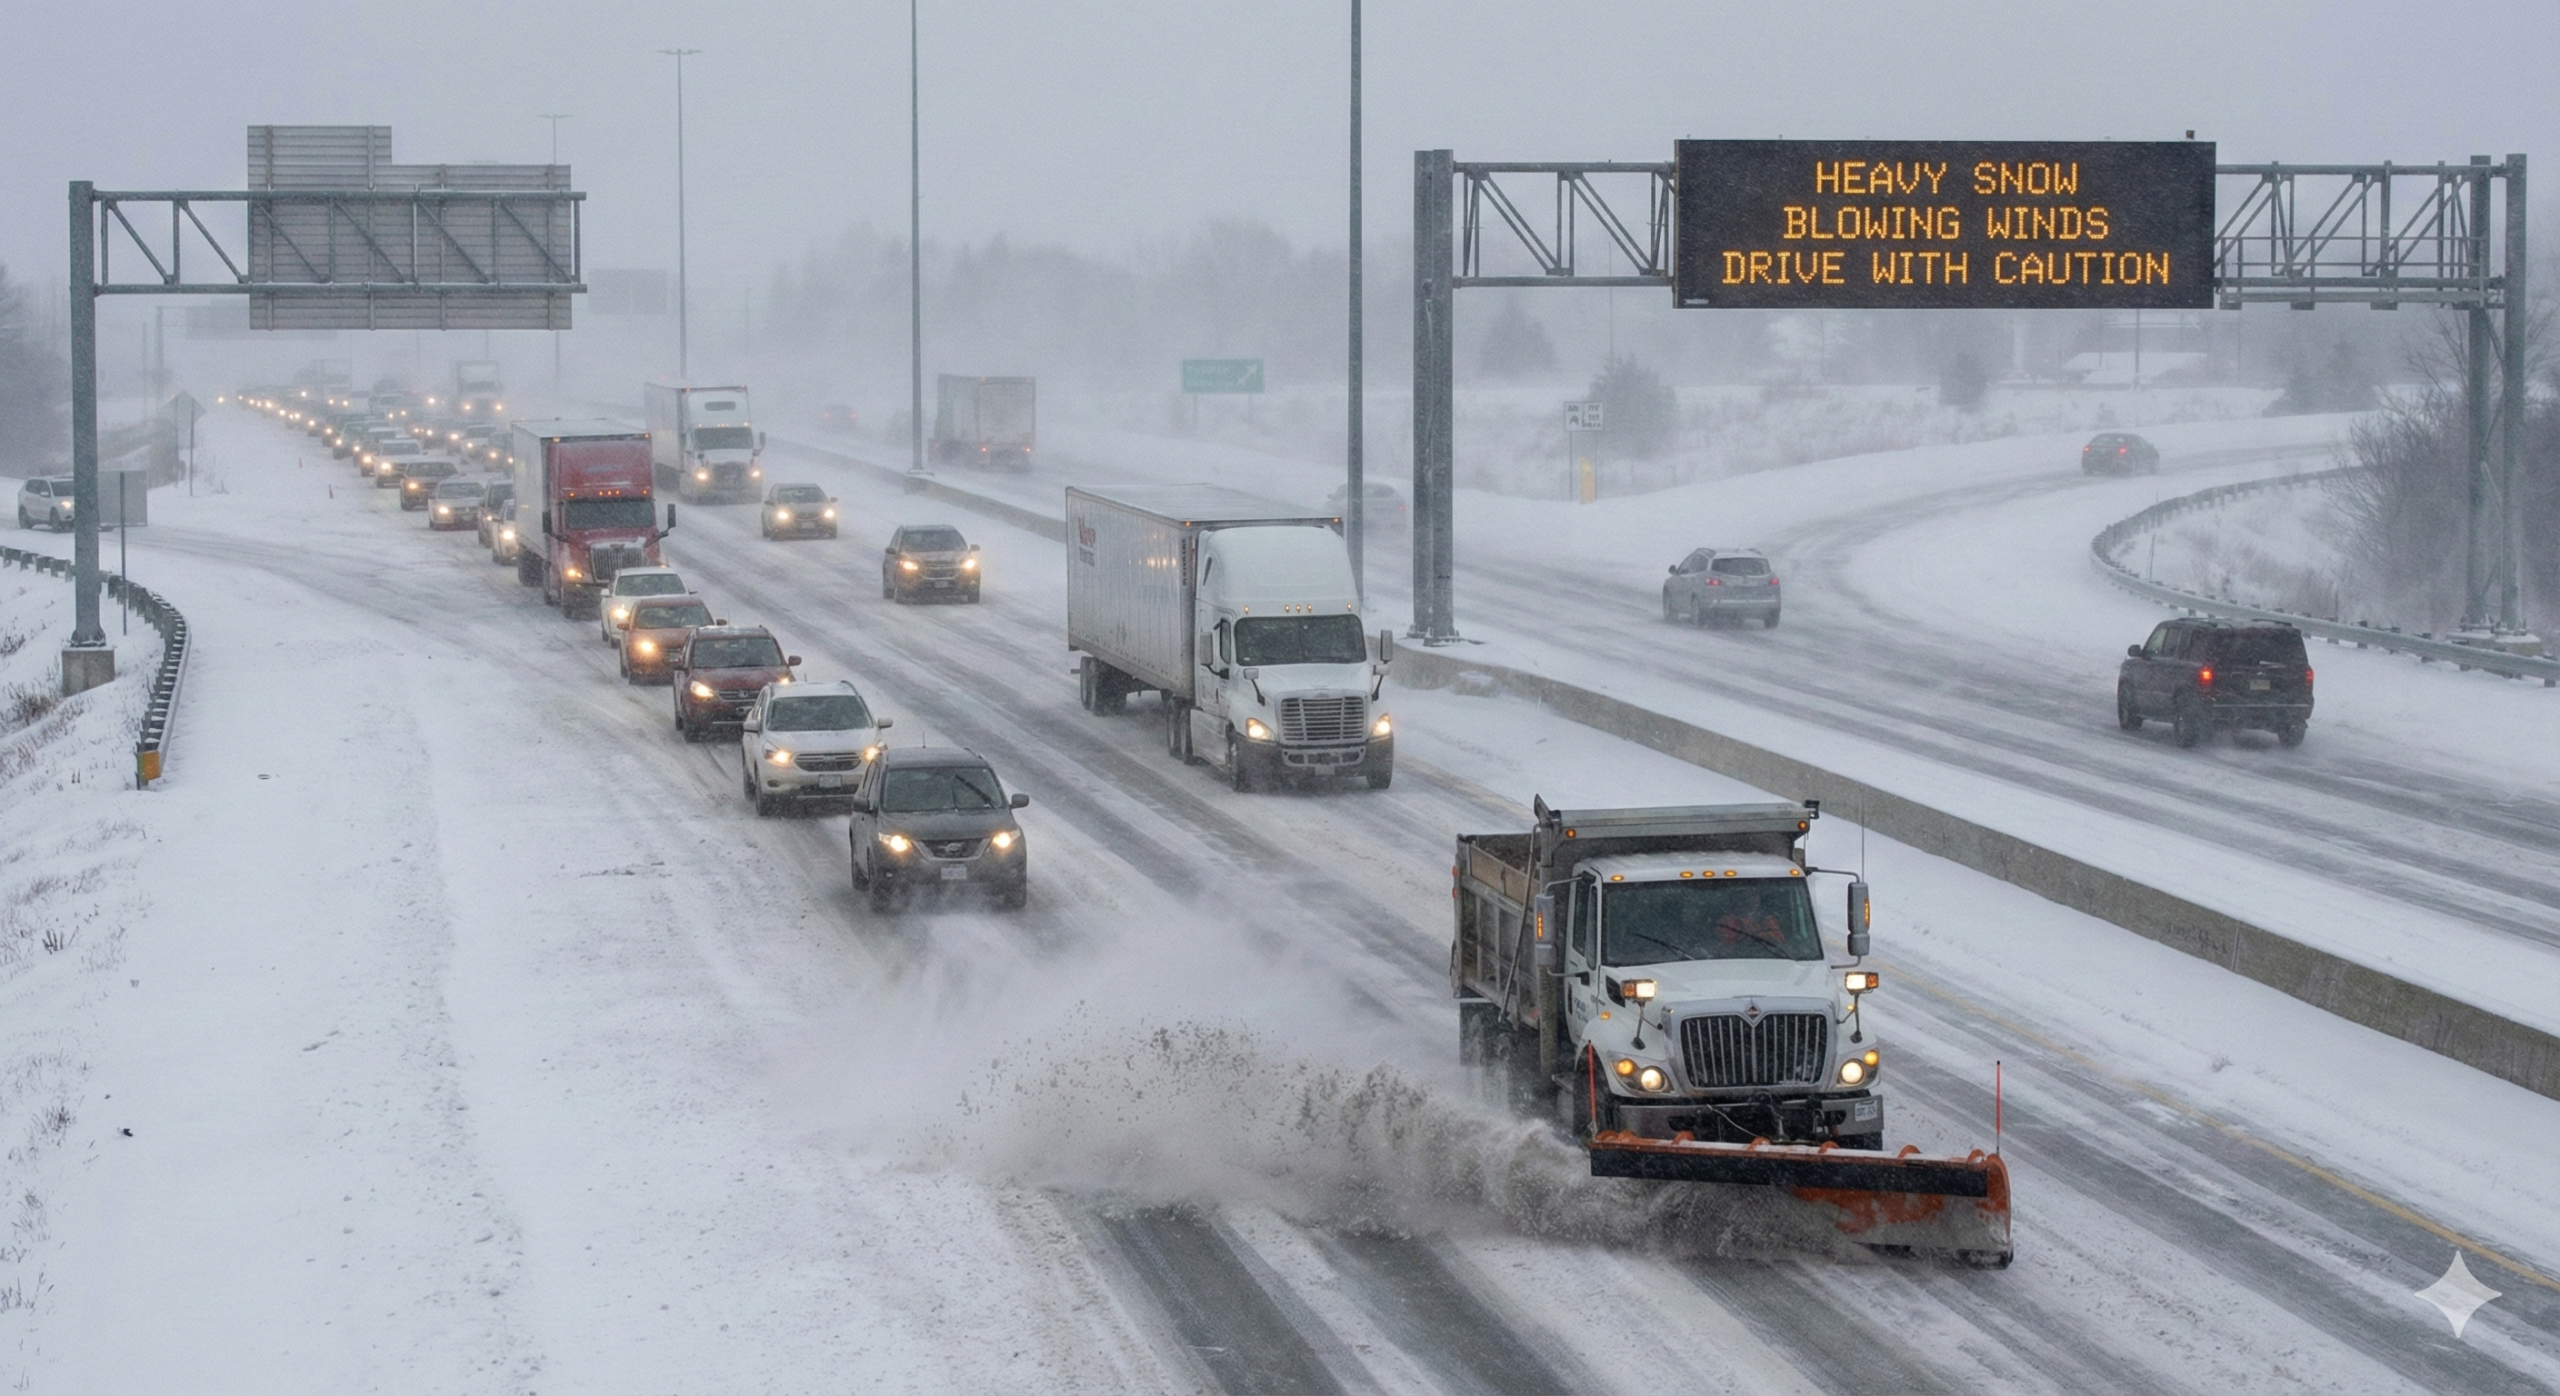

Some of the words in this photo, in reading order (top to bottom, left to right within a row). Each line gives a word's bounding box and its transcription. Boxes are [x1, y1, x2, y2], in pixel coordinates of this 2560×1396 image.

[1816, 161, 1947, 195] HEAVY
[1974, 161, 2078, 195] SNOW
[1783, 205, 1960, 240] BLOWING
[1987, 205, 2109, 240] WINDS
[1722, 251, 1844, 284] DRIVE
[1872, 251, 1968, 284] WITH
[1995, 251, 2169, 284] CAUTION
